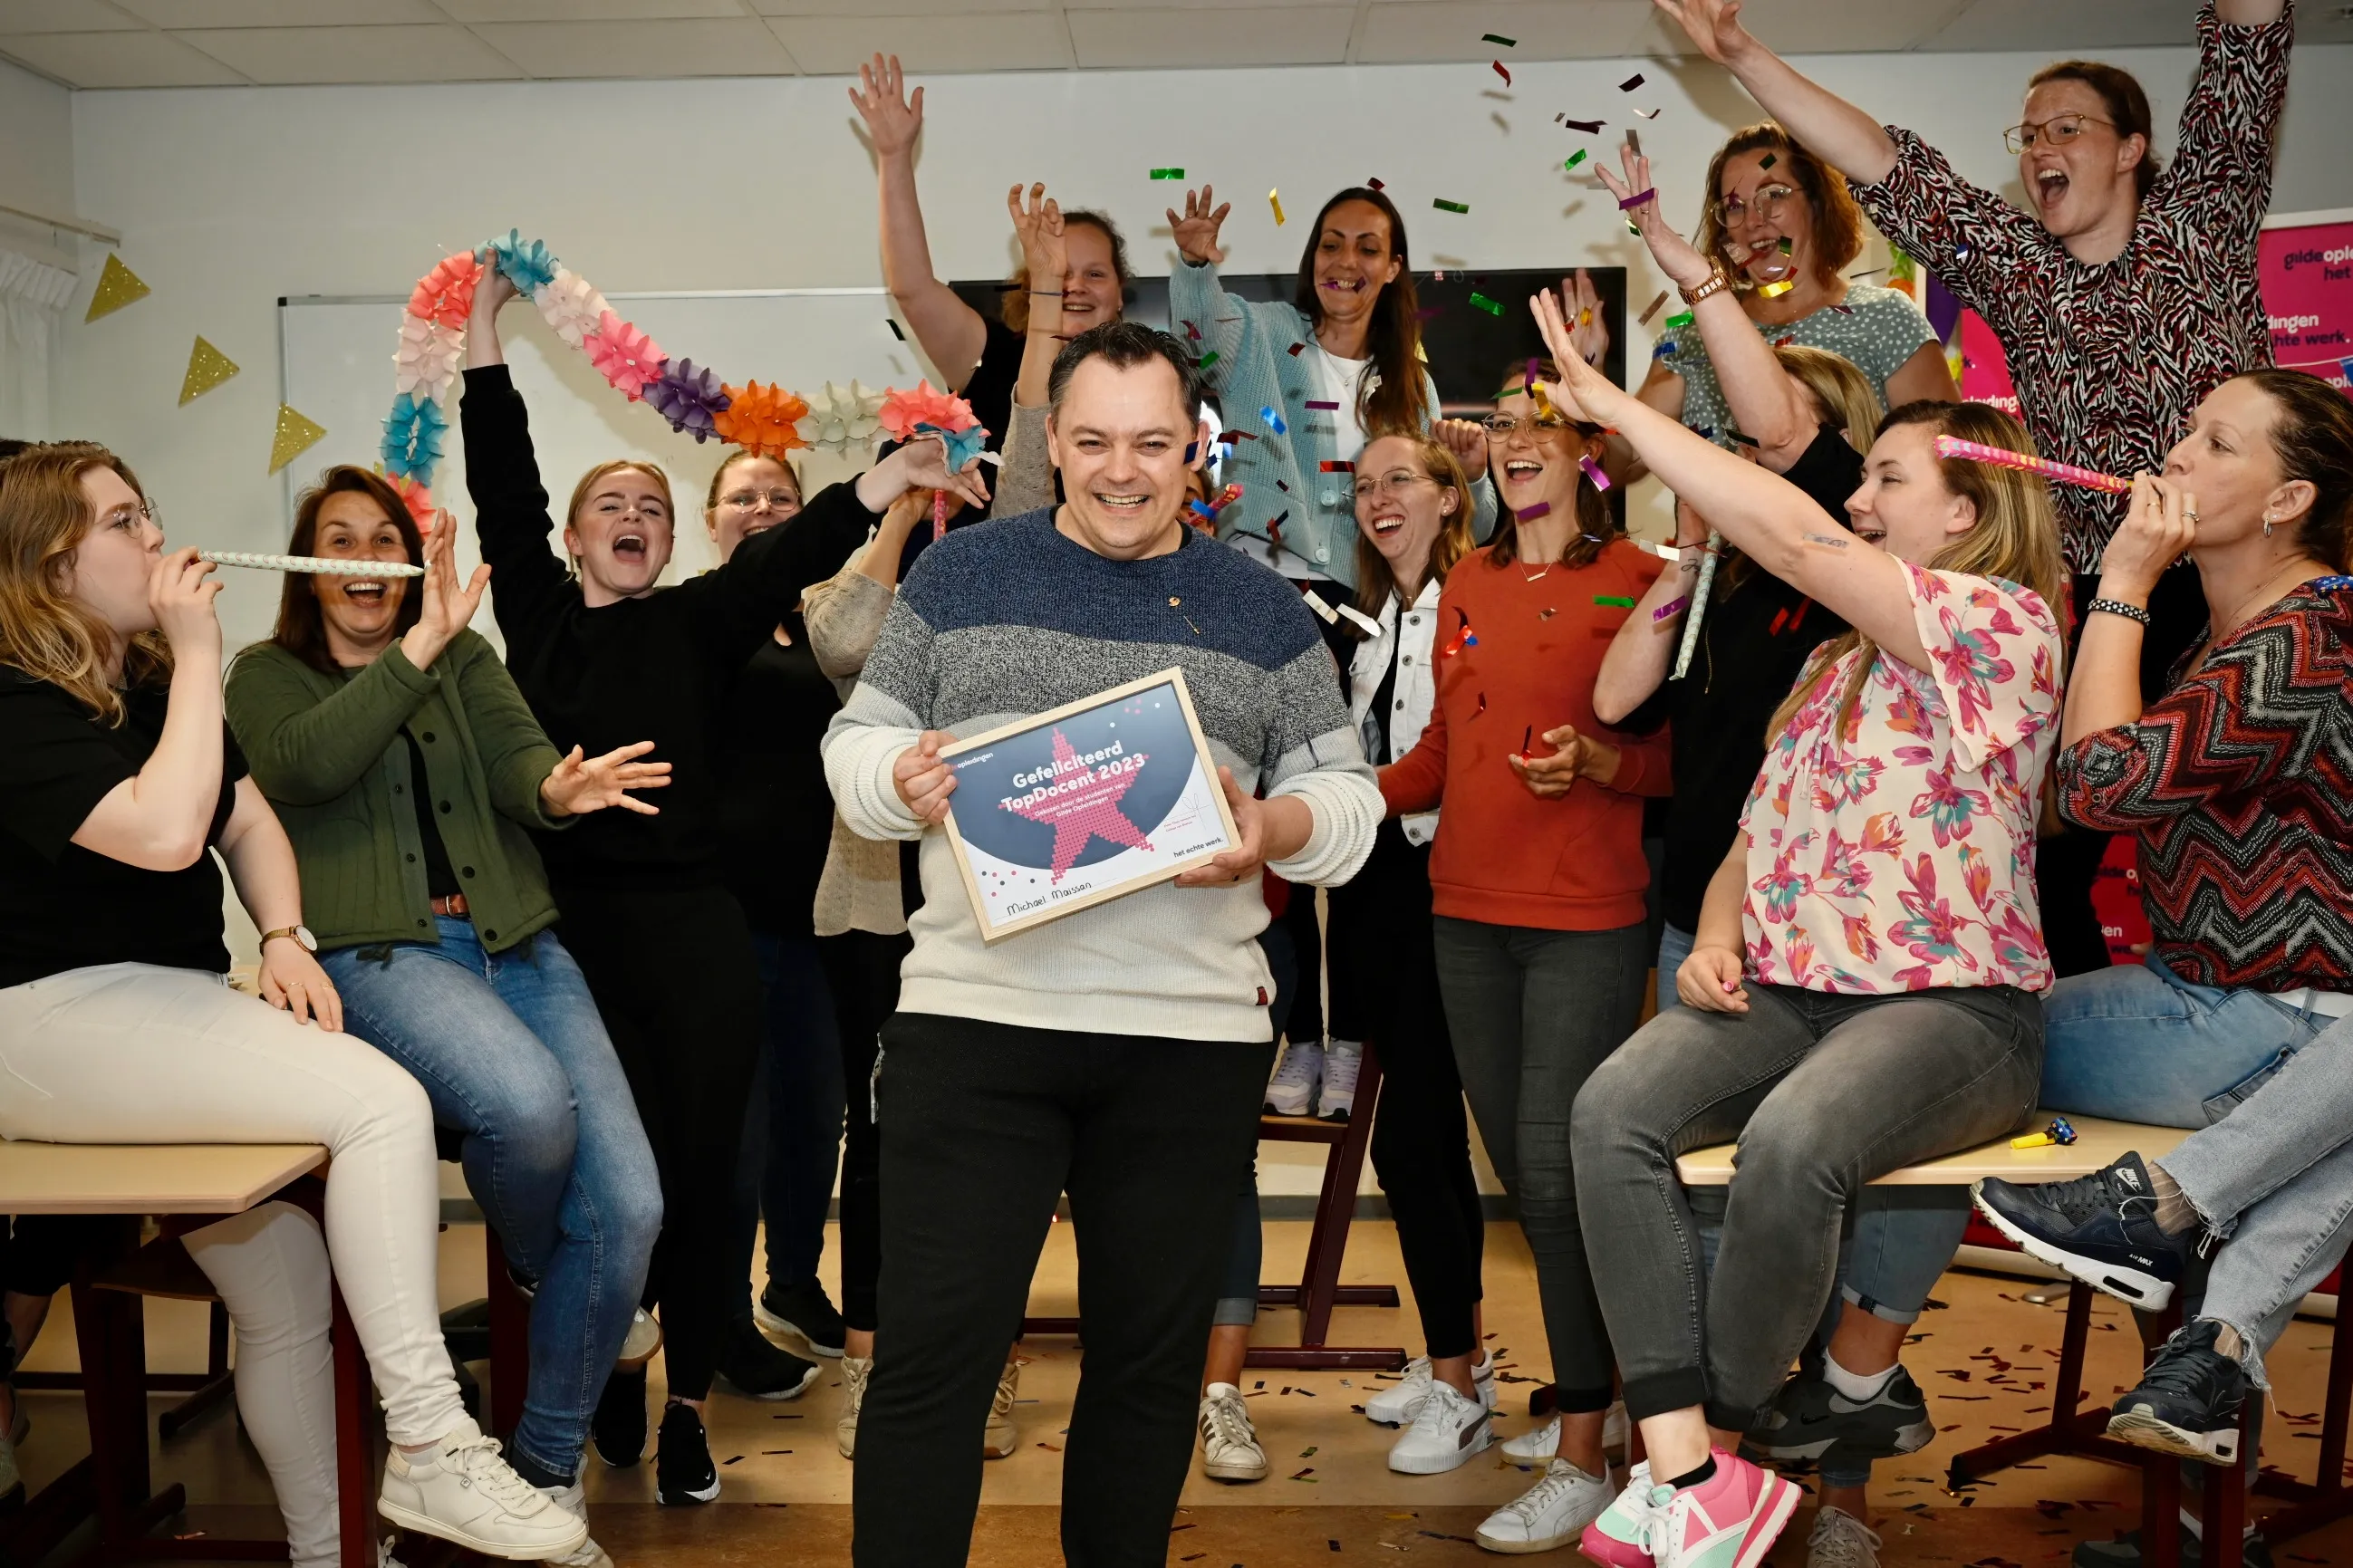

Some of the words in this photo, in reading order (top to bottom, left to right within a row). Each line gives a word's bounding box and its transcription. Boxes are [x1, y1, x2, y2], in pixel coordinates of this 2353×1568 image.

[2324, 265, 2351, 281] het
[2305, 329, 2350, 346] werk.
[956, 752, 994, 769] opleidingen
[1012, 739, 1123, 788] Gefeliciteerd
[1000, 770, 1095, 812] TopDocent
[1098, 753, 1145, 780] 2023
[1035, 805, 1060, 817] Gekozen
[1085, 787, 1114, 800] studenten
[1056, 808, 1073, 817] Gilde
[1073, 796, 1109, 812] Opleidingen
[1173, 849, 1186, 858] het
[1186, 843, 1205, 854] echte
[1205, 836, 1224, 847] werk.
[1007, 895, 1046, 916] Michael
[1051, 881, 1092, 899] Maissan
[2137, 1255, 2154, 1267] MAX
